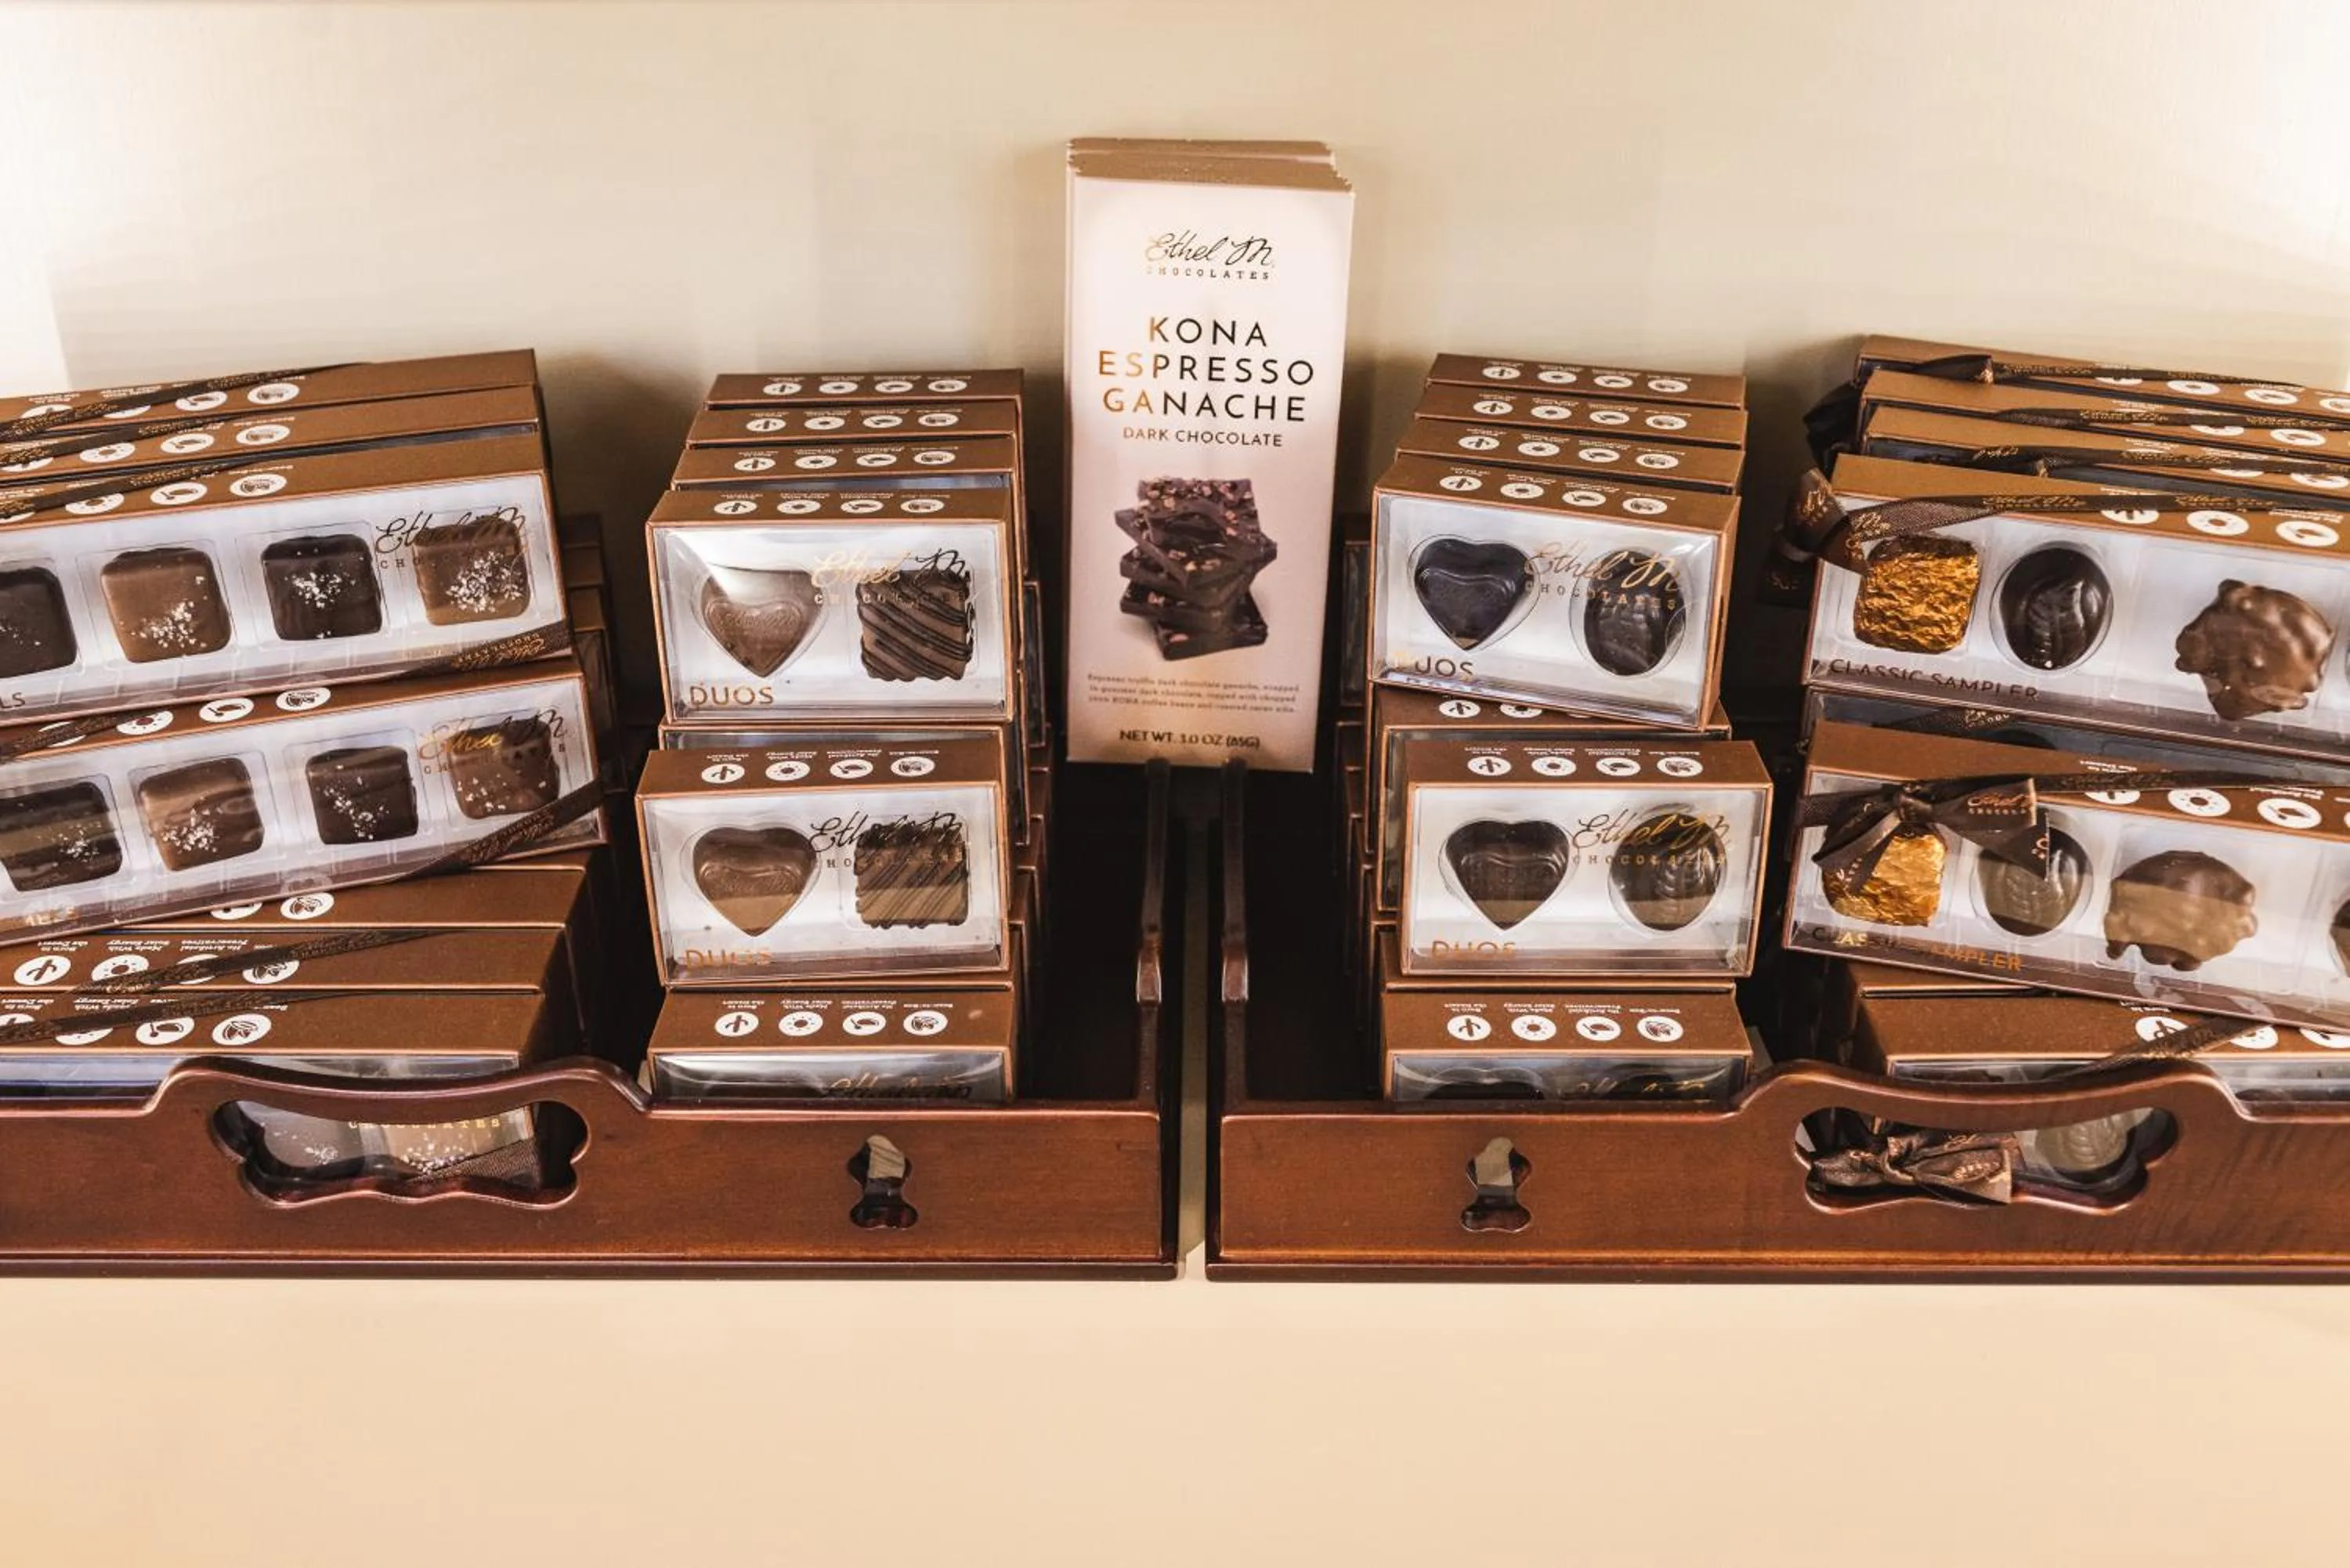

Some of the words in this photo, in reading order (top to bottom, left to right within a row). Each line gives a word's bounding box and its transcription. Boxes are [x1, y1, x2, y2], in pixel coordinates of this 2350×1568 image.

[1144, 229, 1229, 262] Ethel
[1146, 266, 1270, 280] CHOCOLATES
[1149, 316, 1267, 347] KONA
[1098, 349, 1314, 385] ESPRESSO
[1102, 387, 1305, 421] GANACHE
[1123, 426, 1170, 442] DARK
[1175, 430, 1283, 447] CHOCOLATE
[1524, 539, 1629, 580] Ethel
[690, 685, 774, 706] DUOS
[1829, 659, 1922, 682] CLASSIC
[1931, 672, 2039, 702] SAMPLER
[1119, 729, 1148, 742] NET
[1202, 733, 1223, 746] OZ
[1573, 808, 1679, 849] Ethel
